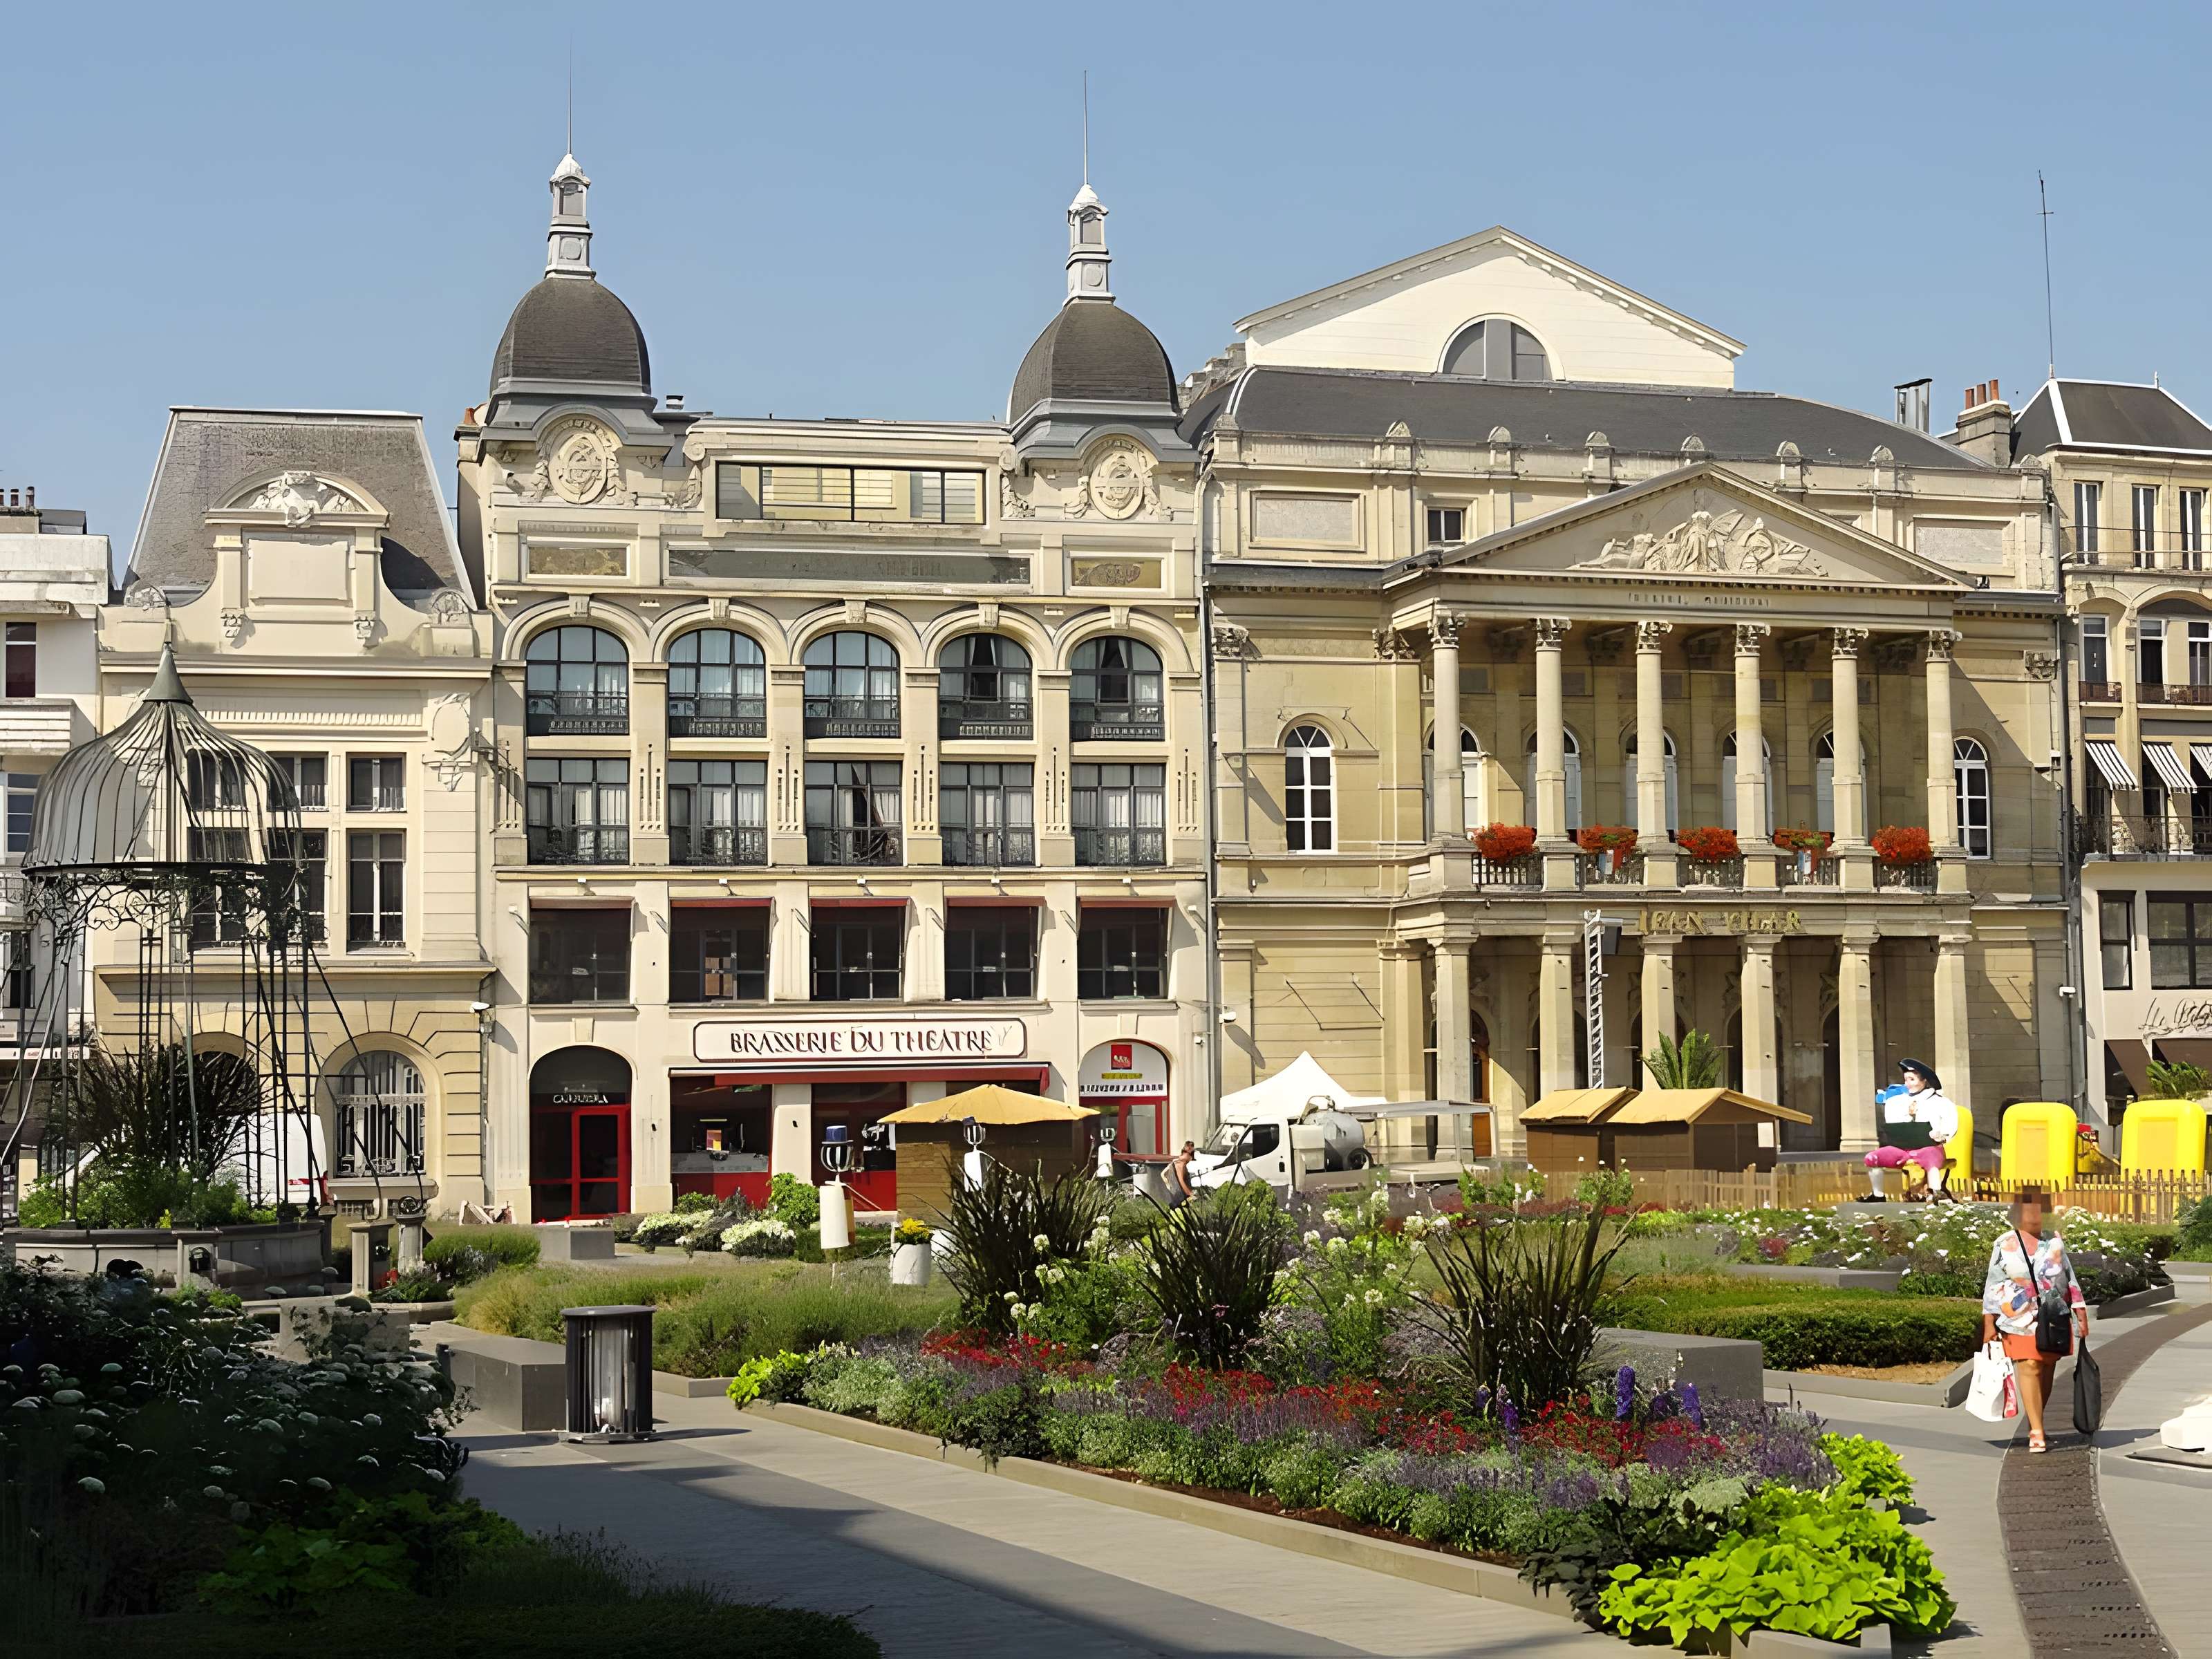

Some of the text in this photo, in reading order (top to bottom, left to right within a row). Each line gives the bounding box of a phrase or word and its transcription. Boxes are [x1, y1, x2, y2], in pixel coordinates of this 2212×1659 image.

[731, 1028, 992, 1055] BRASSERIE DU THEATRE
